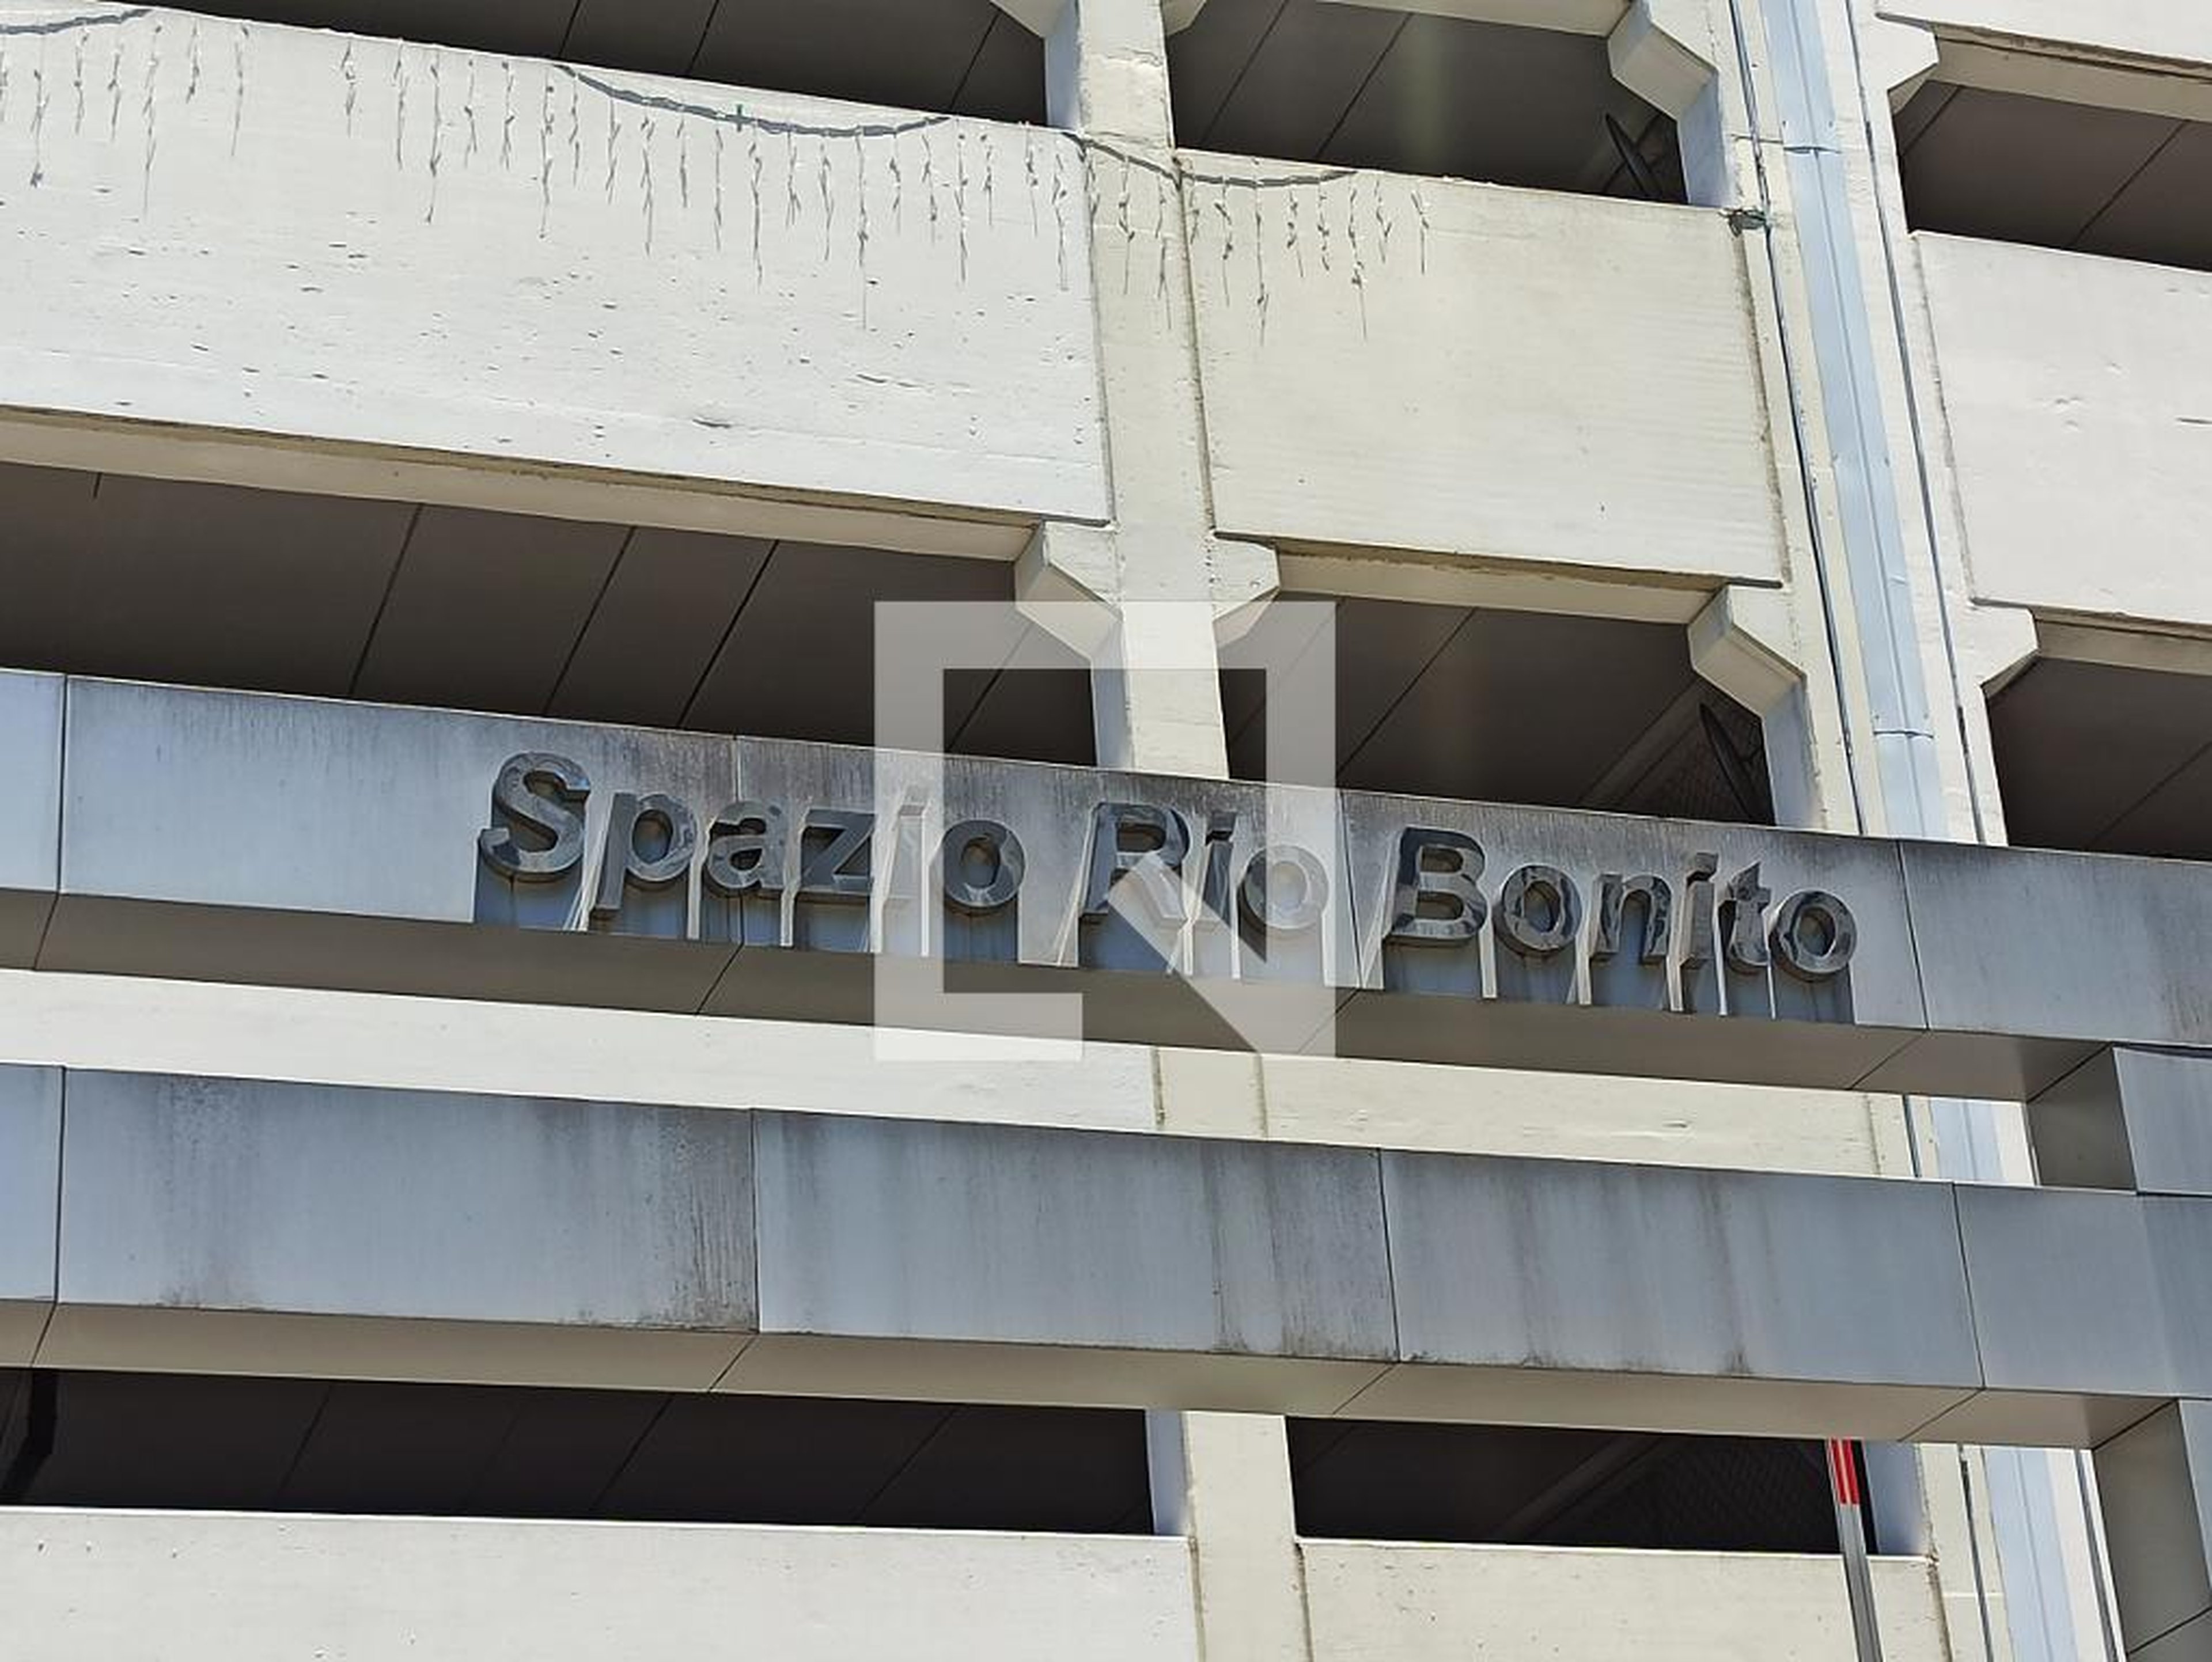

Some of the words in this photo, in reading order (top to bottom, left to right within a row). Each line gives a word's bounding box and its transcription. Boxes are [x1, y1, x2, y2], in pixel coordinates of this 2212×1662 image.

[479, 752, 1025, 917] Spazio
[1079, 802, 1330, 933] Rio
[1385, 826, 1857, 980] Bonito
